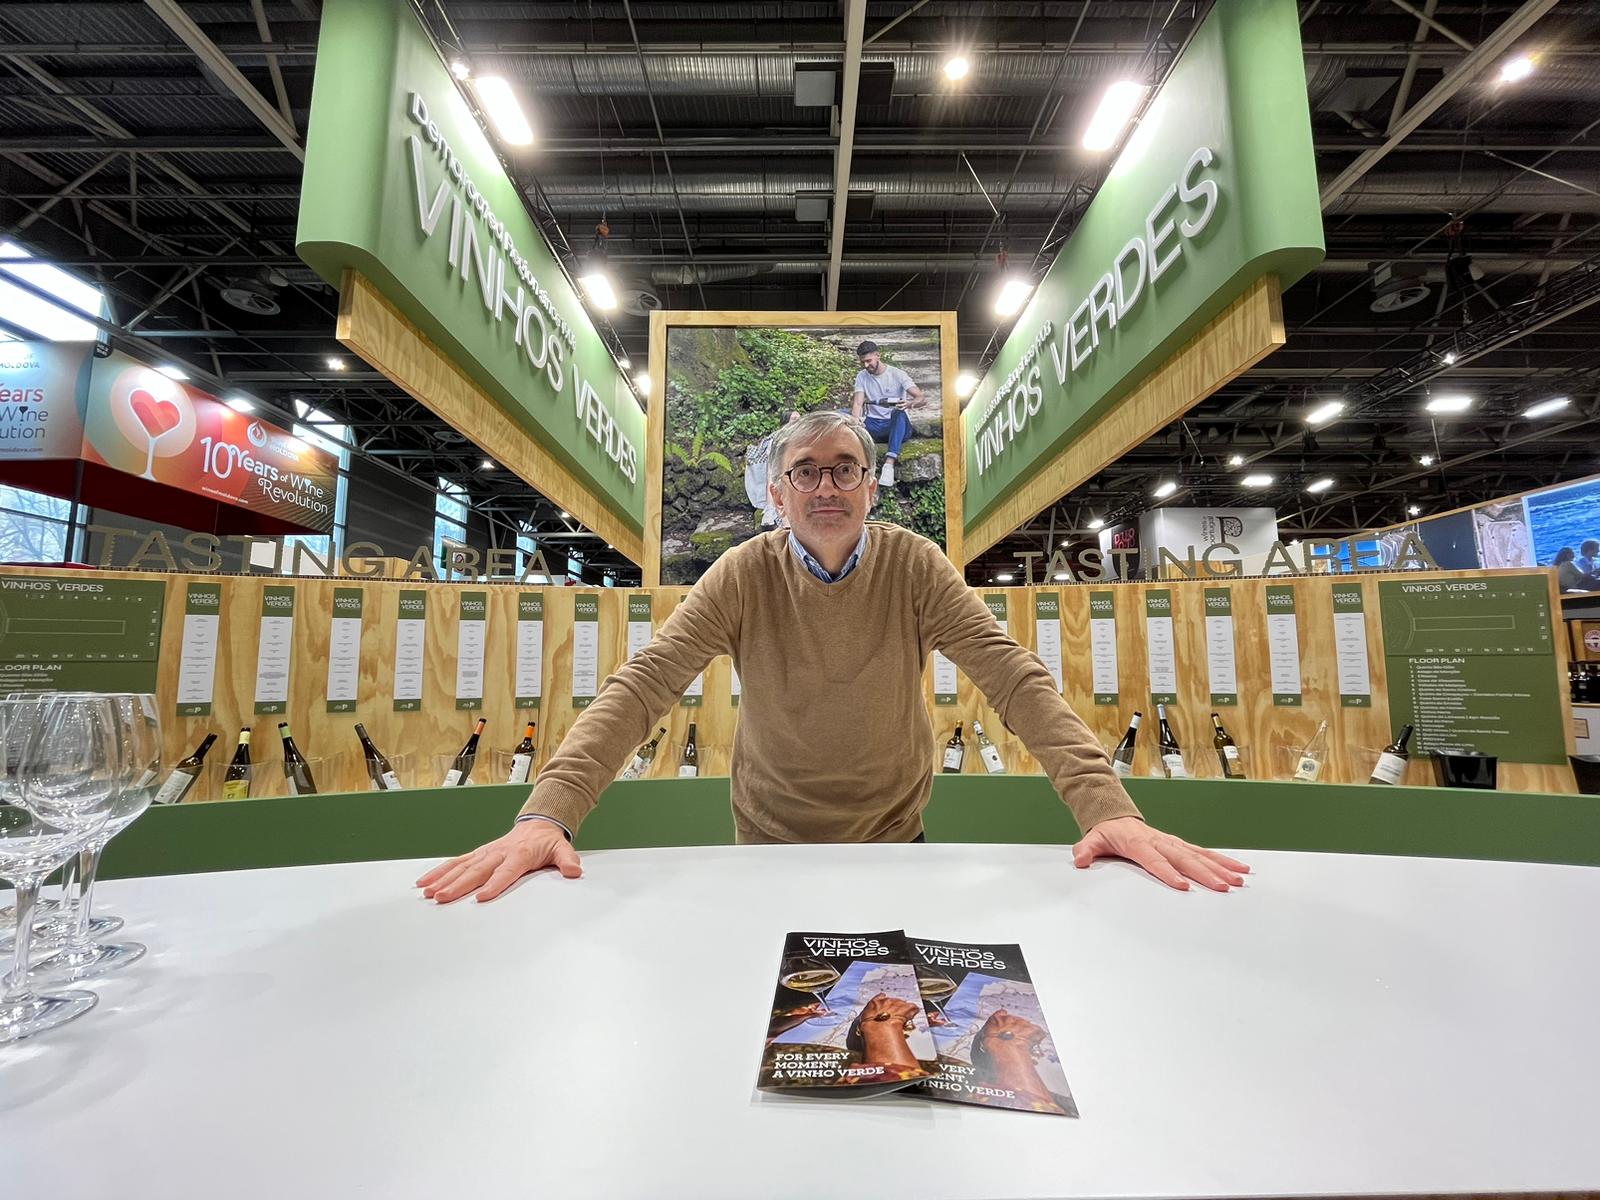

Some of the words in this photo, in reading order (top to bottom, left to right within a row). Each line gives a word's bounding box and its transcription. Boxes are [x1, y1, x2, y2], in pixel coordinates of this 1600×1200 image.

[411, 91, 503, 241] Demarcated
[410, 135, 563, 392] VINHOS
[573, 364, 637, 485] VERDES
[975, 365, 1042, 476] VINHOS
[1050, 147, 1218, 385] VERDES
[0, 384, 44, 403] ears
[200, 436, 234, 479] 10
[229, 444, 279, 481] Years
[280, 474, 289, 483] of
[291, 473, 324, 498] Wine
[258, 478, 328, 515] Revolution
[89, 525, 385, 577] TASTING
[403, 546, 553, 584] AREA
[1013, 542, 1243, 586] TASTING
[1262, 531, 1438, 576] AREA
[1, 581, 51, 591] VINHOS
[56, 583, 104, 593] VERDES
[1402, 584, 1442, 593] VINHOS
[1445, 582, 1488, 591] VERDES
[803, 939, 880, 948] VINHOS
[810, 947, 890, 957] VERDES
[915, 945, 996, 961] VINHOS
[923, 955, 1007, 970] VERDES
[775, 1053, 803, 1061] FOR
[806, 1052, 850, 1060] EVERY
[772, 1070, 783, 1078] A
[786, 1070, 835, 1078] VINHO
[838, 1067, 885, 1077] VERDE
[774, 1061, 842, 1070] MOMENT,
[939, 1063, 976, 1076] VERY
[965, 1085, 1015, 1099] VERDE
